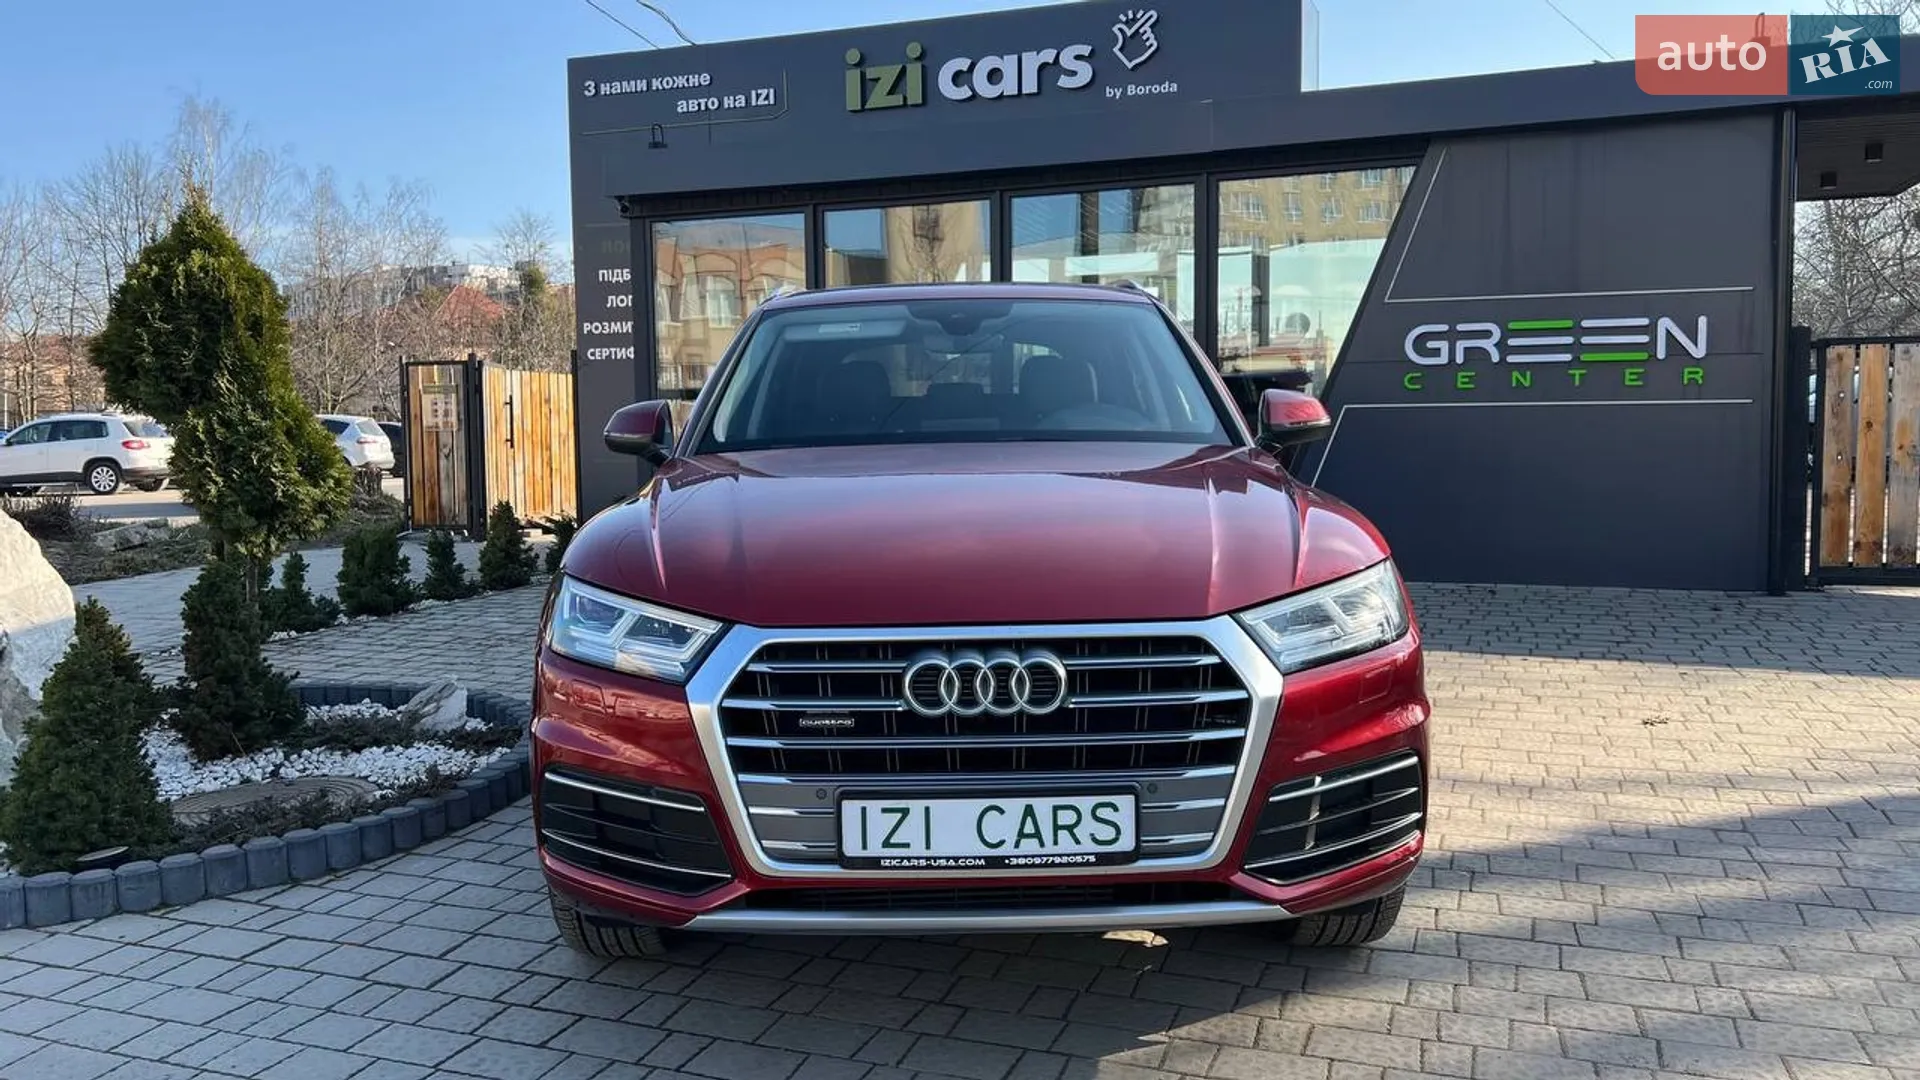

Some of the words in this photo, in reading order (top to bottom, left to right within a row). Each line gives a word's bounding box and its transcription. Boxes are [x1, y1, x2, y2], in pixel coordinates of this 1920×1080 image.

[600, 78, 648, 96] нами
[652, 73, 711, 91] кожне
[845, 41, 923, 111] izi
[938, 44, 1094, 101] cars
[676, 96, 719, 114] авто
[723, 92, 746, 108] на
[751, 88, 776, 106] IZI
[1105, 85, 1124, 99] by
[1127, 80, 1178, 96] Boroda
[583, 321, 634, 334] РОЗМИ
[1404, 315, 1707, 366] GREEN
[1404, 368, 1704, 390] CENTER
[861, 806, 931, 850] IZI
[976, 801, 1122, 849] CARS
[880, 857, 986, 867] IZICARS-USA.COM
